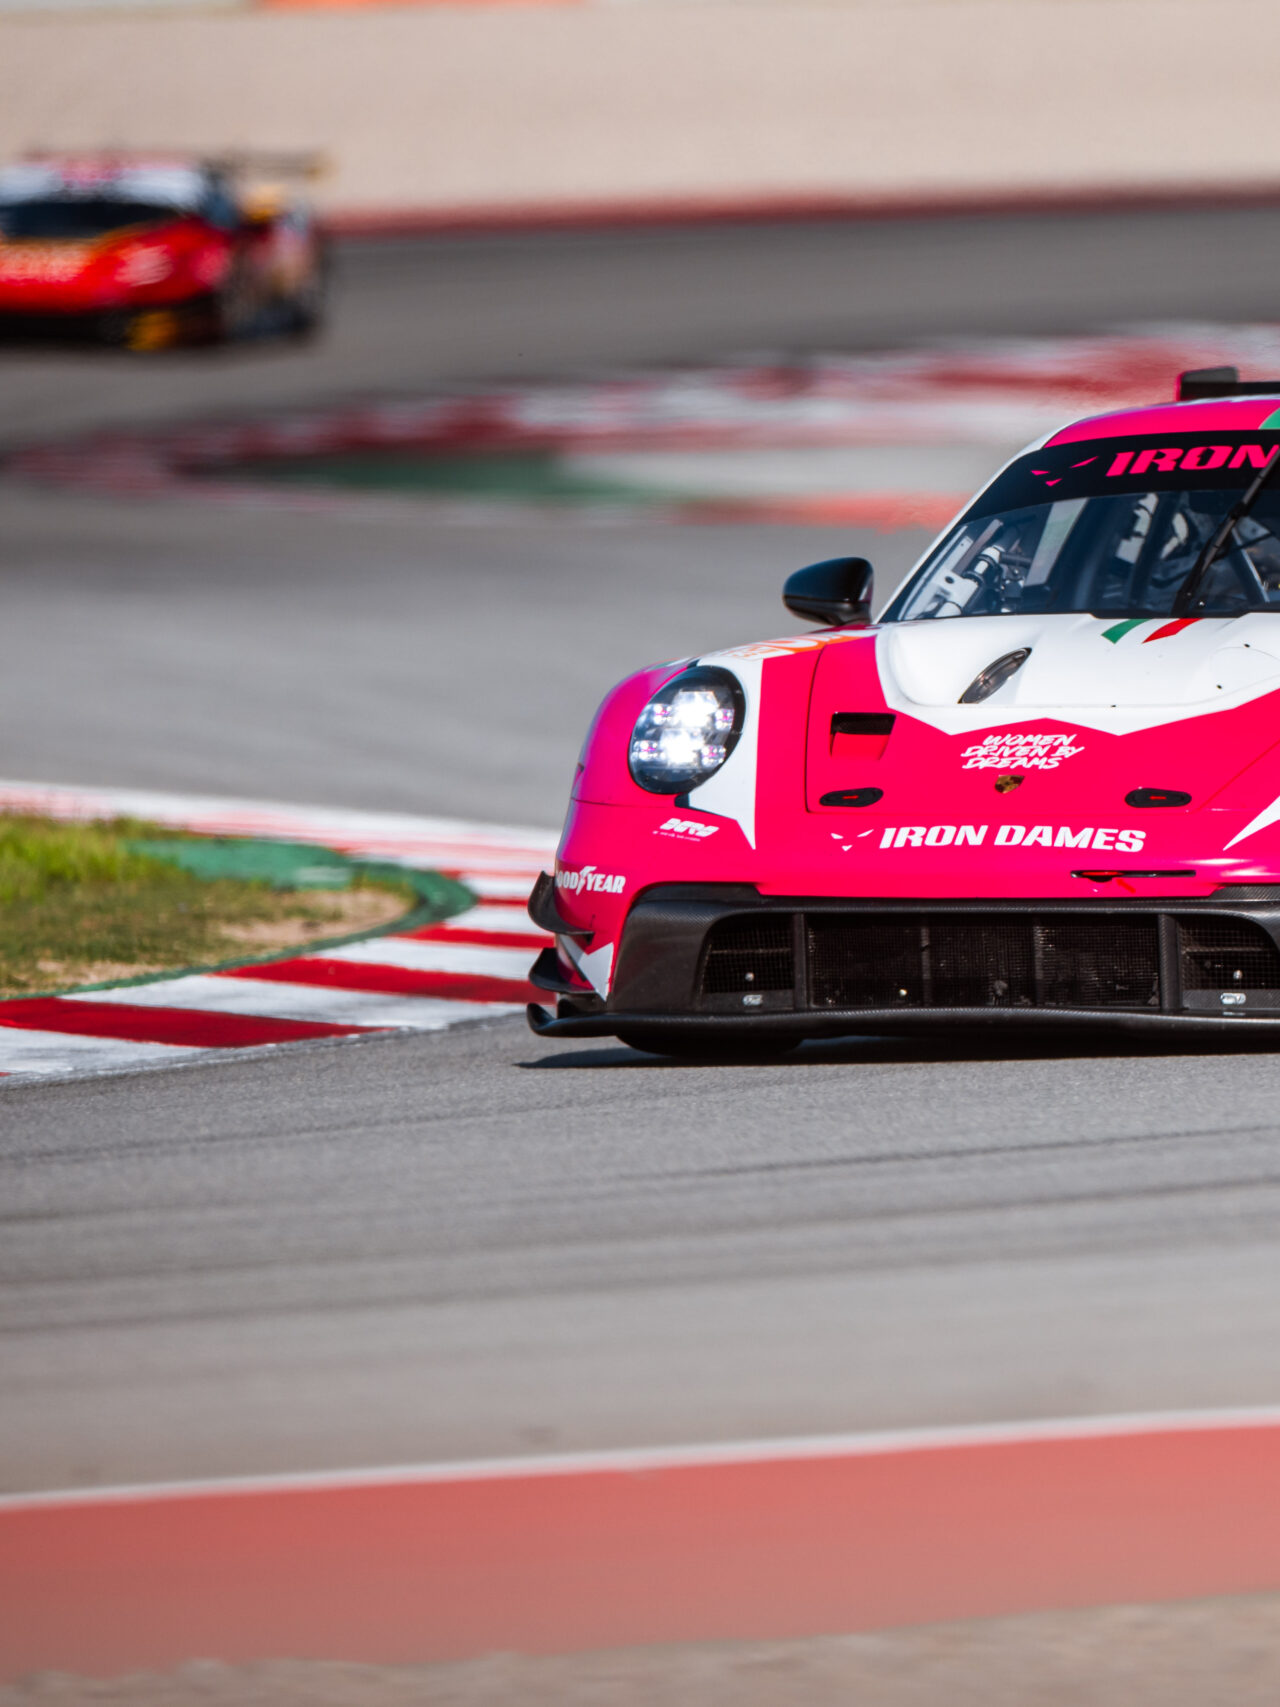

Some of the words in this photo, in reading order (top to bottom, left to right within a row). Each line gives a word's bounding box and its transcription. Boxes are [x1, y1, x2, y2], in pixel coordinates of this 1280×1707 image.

[1106, 443, 1280, 477] IRON
[983, 734, 1077, 746] WOMEN
[961, 745, 1051, 757] DRIVEN
[1051, 746, 1085, 758] BY
[962, 757, 1062, 769] DREAMS
[880, 825, 988, 849] IRON
[994, 825, 1146, 852] DAMES
